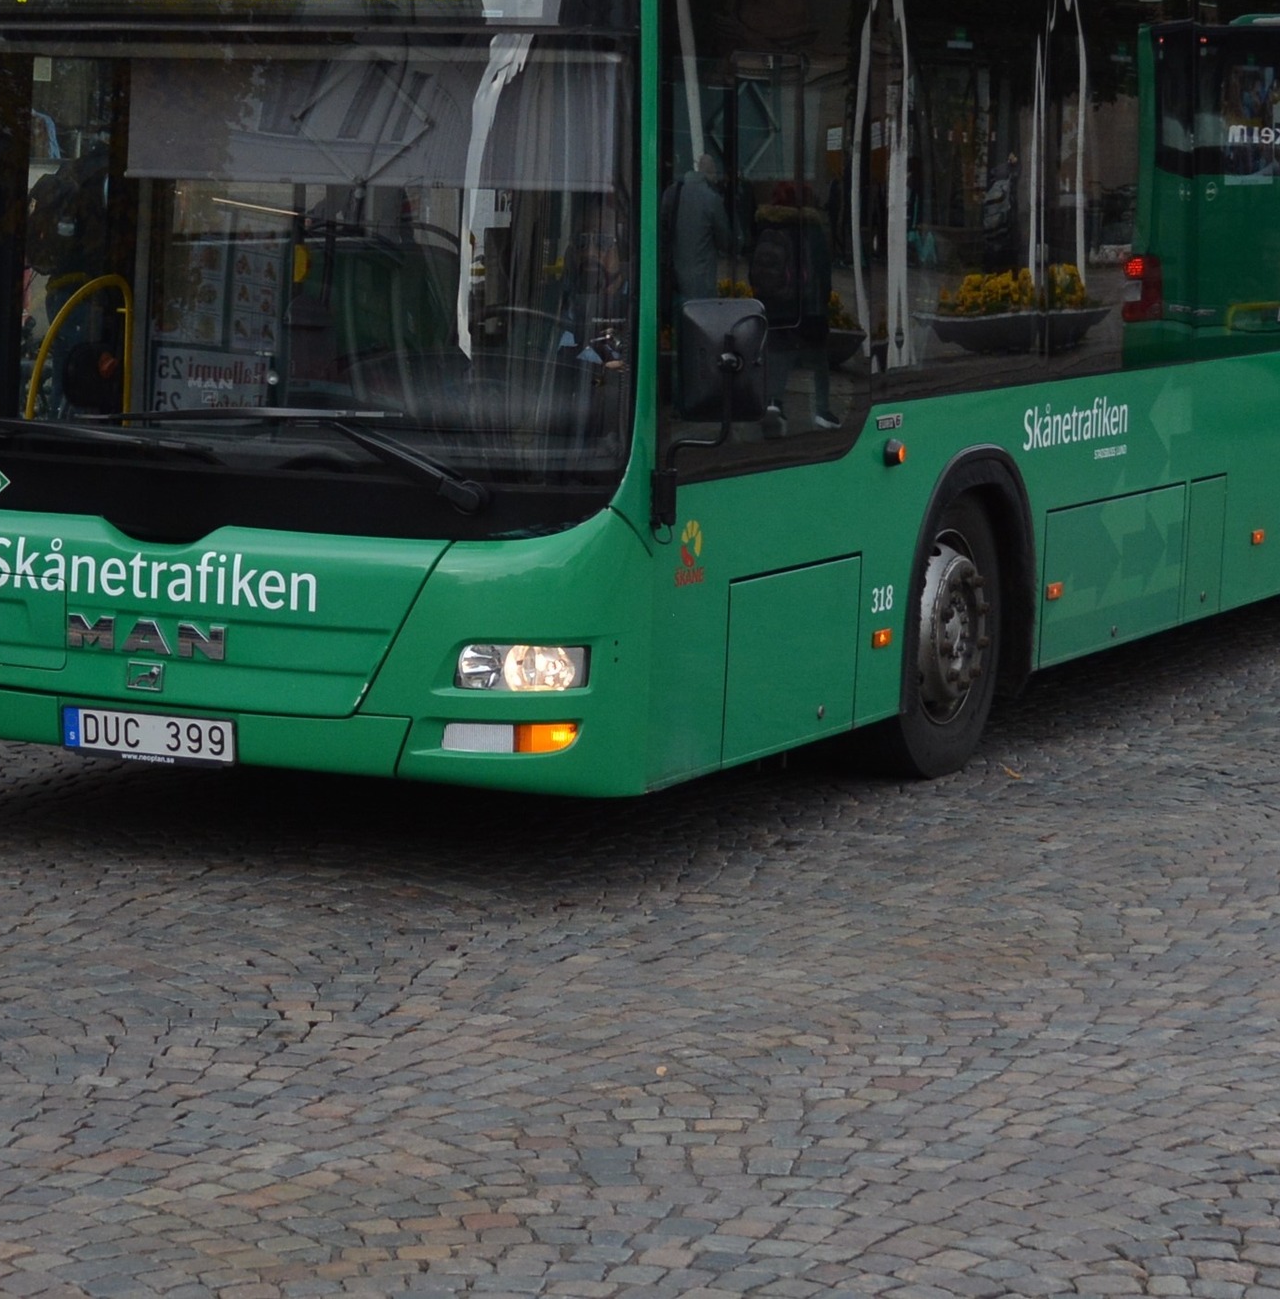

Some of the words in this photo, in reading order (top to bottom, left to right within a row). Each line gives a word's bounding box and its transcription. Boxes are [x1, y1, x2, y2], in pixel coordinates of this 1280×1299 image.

[1022, 395, 1129, 452] Skånetrafiken
[871, 584, 894, 614] 318
[68, 612, 228, 662] MAN
[69, 731, 76, 740] S
[83, 713, 140, 748] DUC
[166, 721, 225, 756] 399
[121, 752, 175, 764] www.neoplan.se
